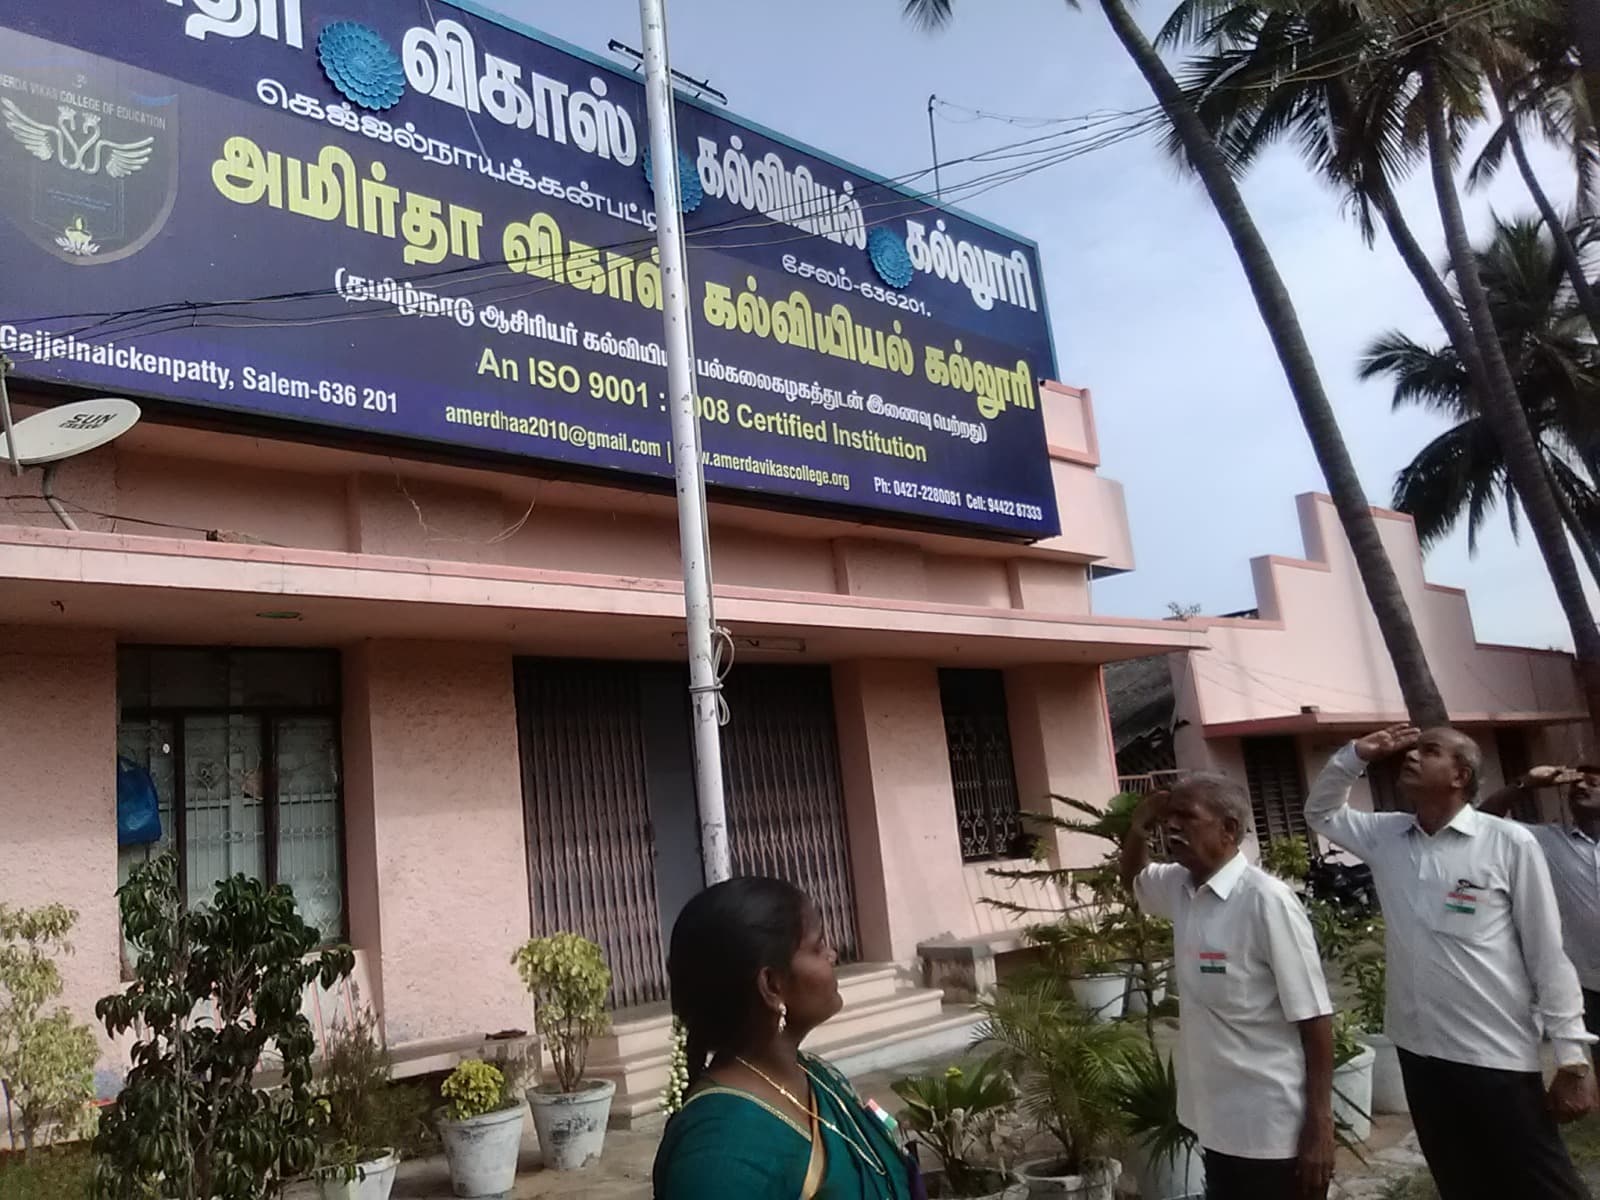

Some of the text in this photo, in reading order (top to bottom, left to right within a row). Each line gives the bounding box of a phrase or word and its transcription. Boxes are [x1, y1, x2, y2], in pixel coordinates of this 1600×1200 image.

[0, 74, 27, 92] ERDA
[59, 90, 100, 112] COLLEGE
[102, 102, 115, 116] OF
[402, 19, 637, 166] விகாஸ்
[906, 218, 1038, 311] கல்லூரி
[211, 136, 483, 265] அமிர்தா
[703, 276, 915, 376] கல்வியியல்
[925, 338, 1036, 419] கல்லூரி
[242, 367, 357, 408] Salem-636
[362, 389, 399, 414] 201
[477, 348, 519, 382] An
[528, 357, 582, 394] ISO
[588, 371, 648, 408] 9001
[736, 403, 828, 443] Certified
[832, 422, 928, 463] Institution
[445, 406, 662, 458] amerdhaa2010@gmail.com
[700, 450, 851, 491] w.amerdavikascollege.org
[873, 476, 893, 495] Ph:
[893, 480, 963, 508] 0427-2280081
[965, 493, 987, 512] Cell:
[987, 497, 1015, 517] 94422
